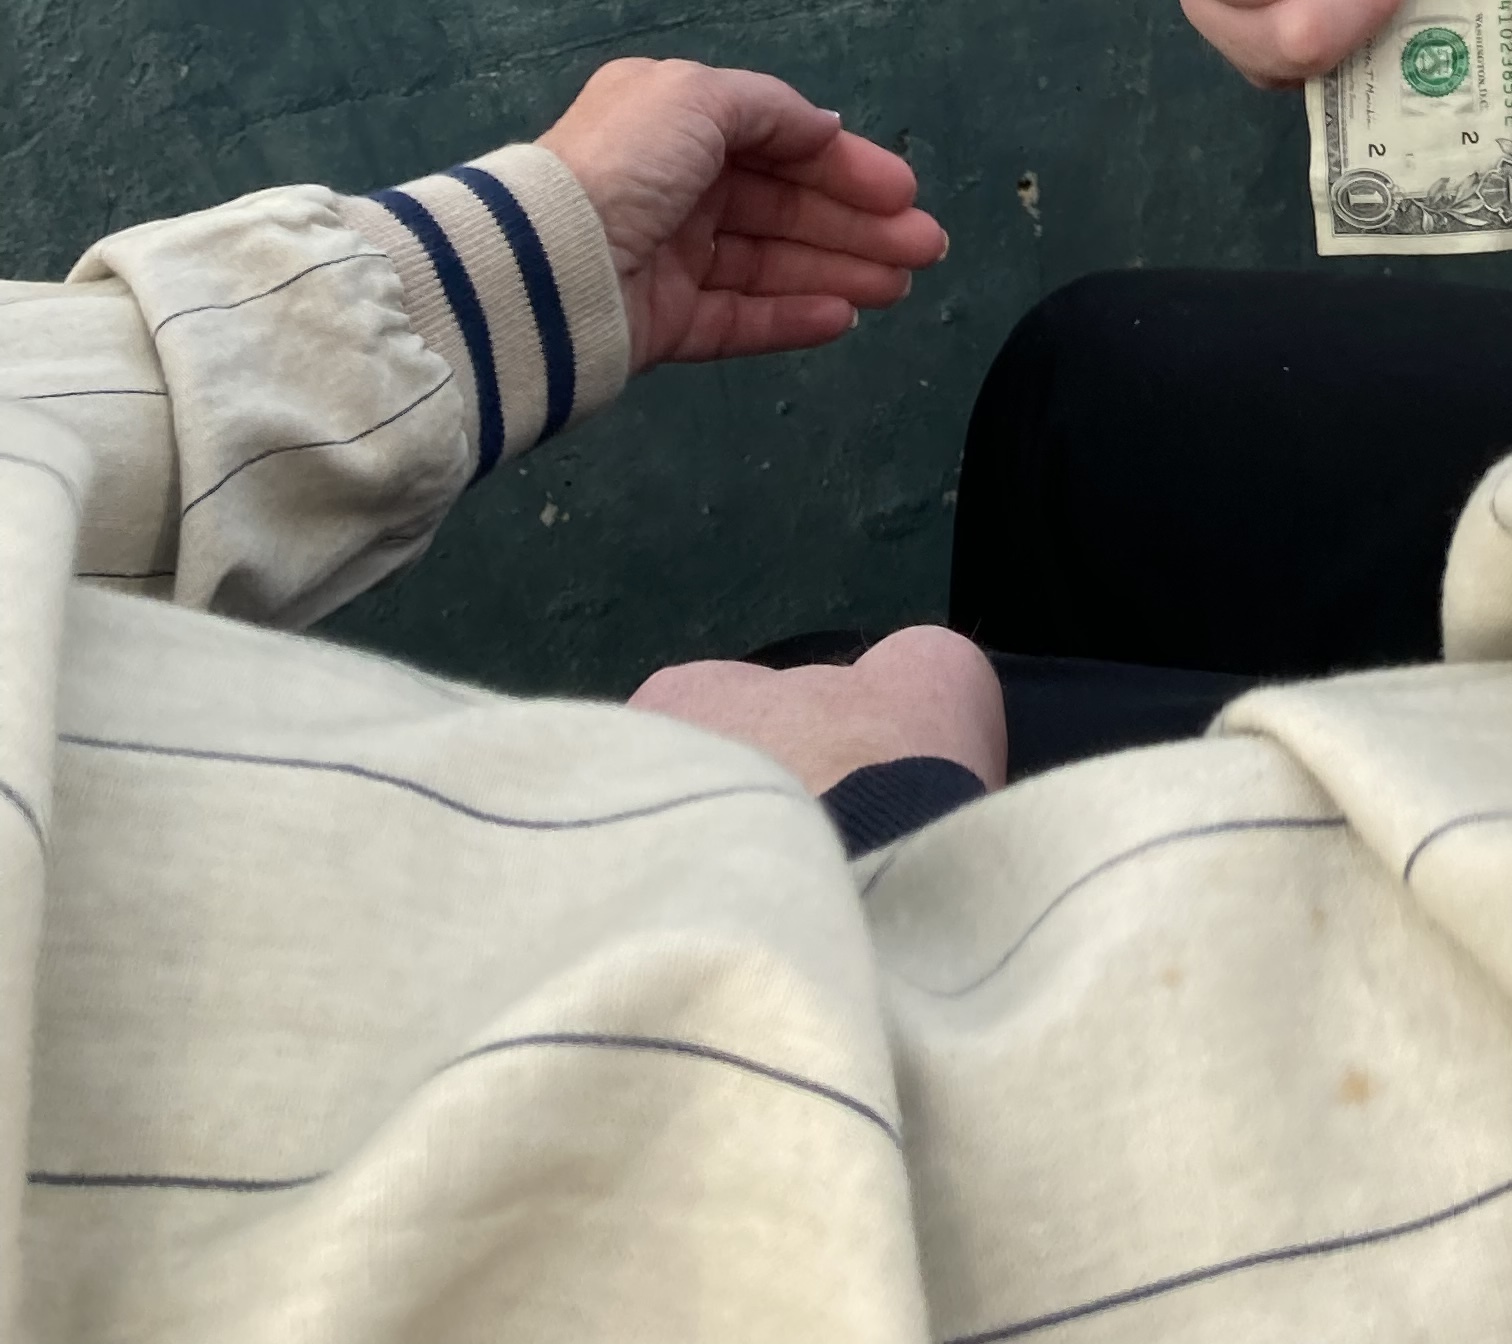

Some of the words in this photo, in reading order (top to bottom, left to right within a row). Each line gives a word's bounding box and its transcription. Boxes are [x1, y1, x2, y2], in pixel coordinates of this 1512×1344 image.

[1461, 130, 1480, 146] 2
[1367, 143, 1387, 158] 2
[1348, 190, 1384, 206] 1
